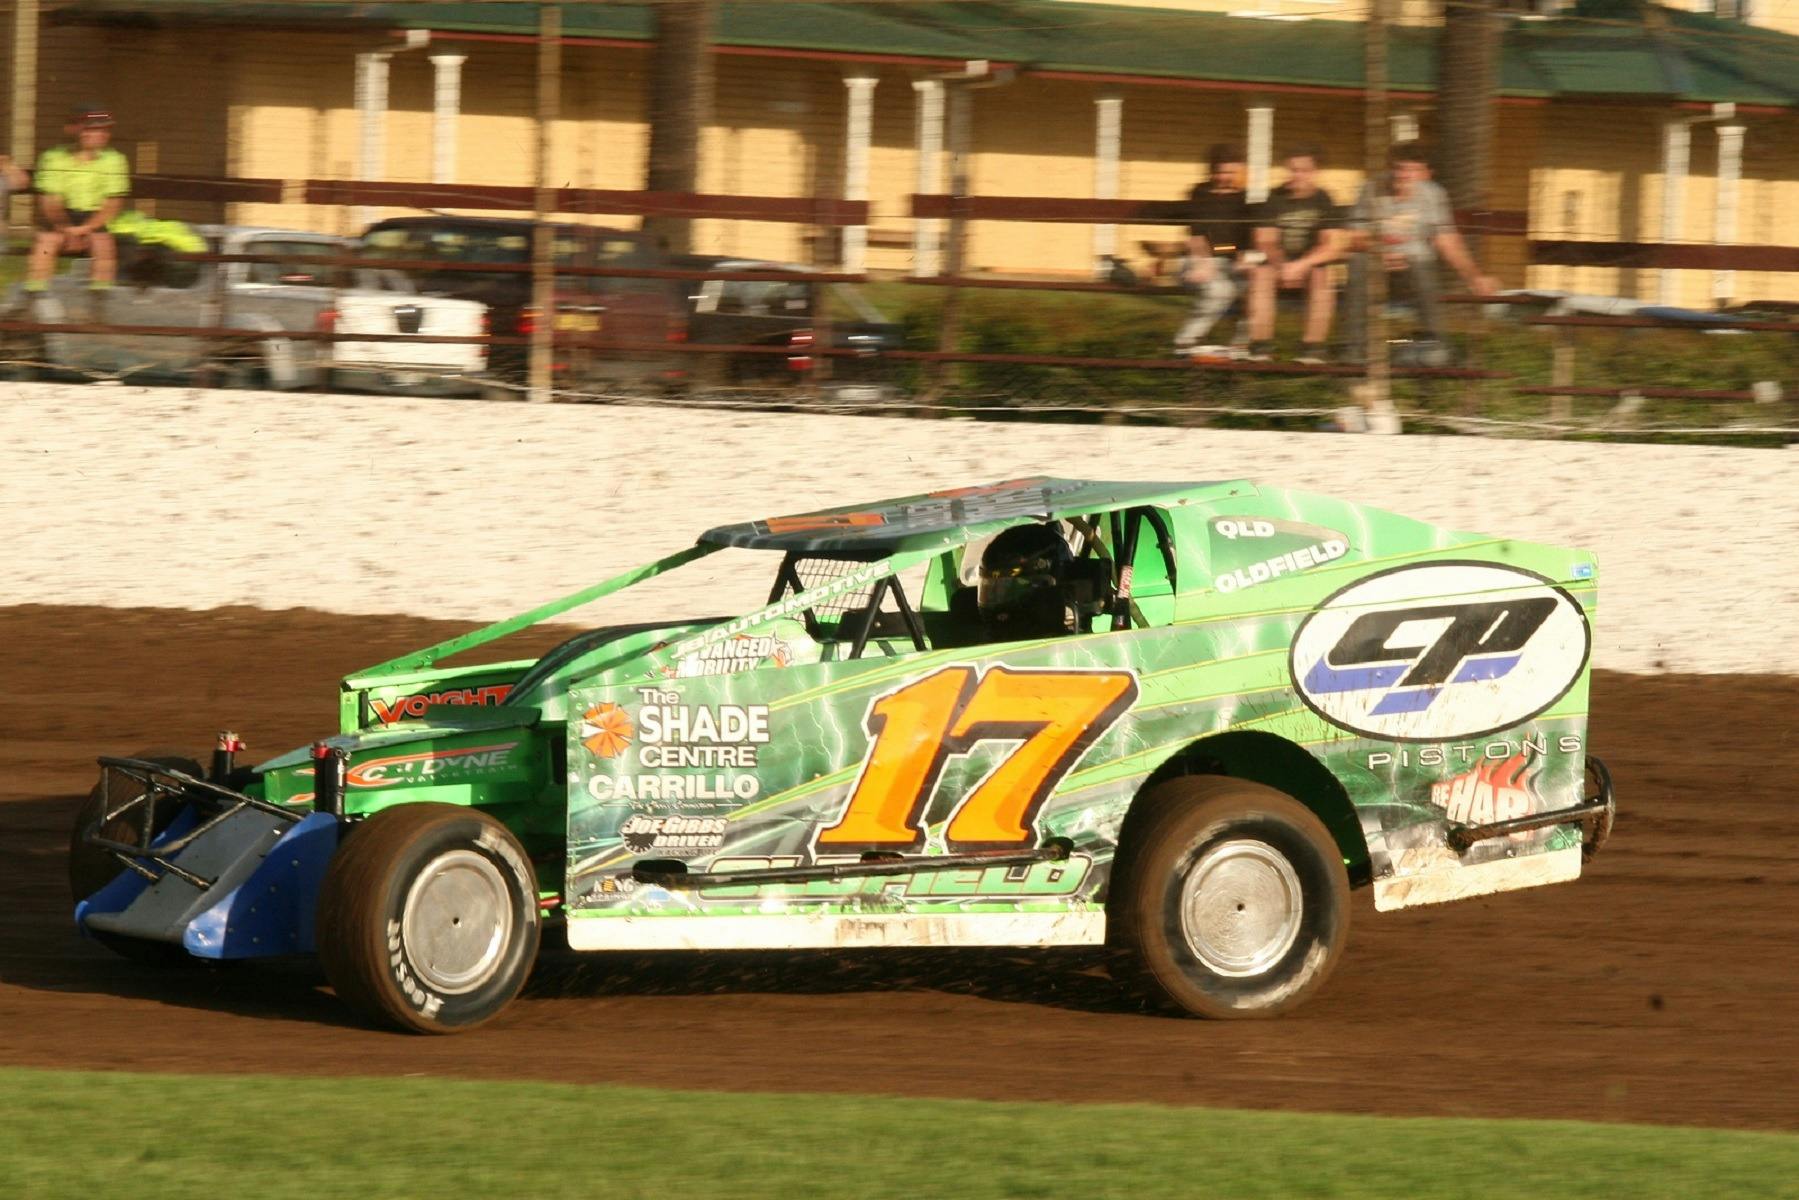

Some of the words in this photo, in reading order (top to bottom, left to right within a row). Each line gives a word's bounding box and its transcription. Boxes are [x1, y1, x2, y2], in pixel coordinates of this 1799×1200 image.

[1216, 520, 1275, 539] QLD
[1215, 539, 1346, 593] OLDFIELD
[710, 560, 891, 641] AUTOMOTIVE
[639, 688, 679, 705] The
[638, 705, 770, 743] SHADE
[638, 745, 757, 768] CENTRE
[811, 664, 1138, 852] 17
[1367, 735, 1583, 770] PISTONS
[588, 774, 760, 800] CARRILLO
[653, 835, 722, 847] DRIVEN
